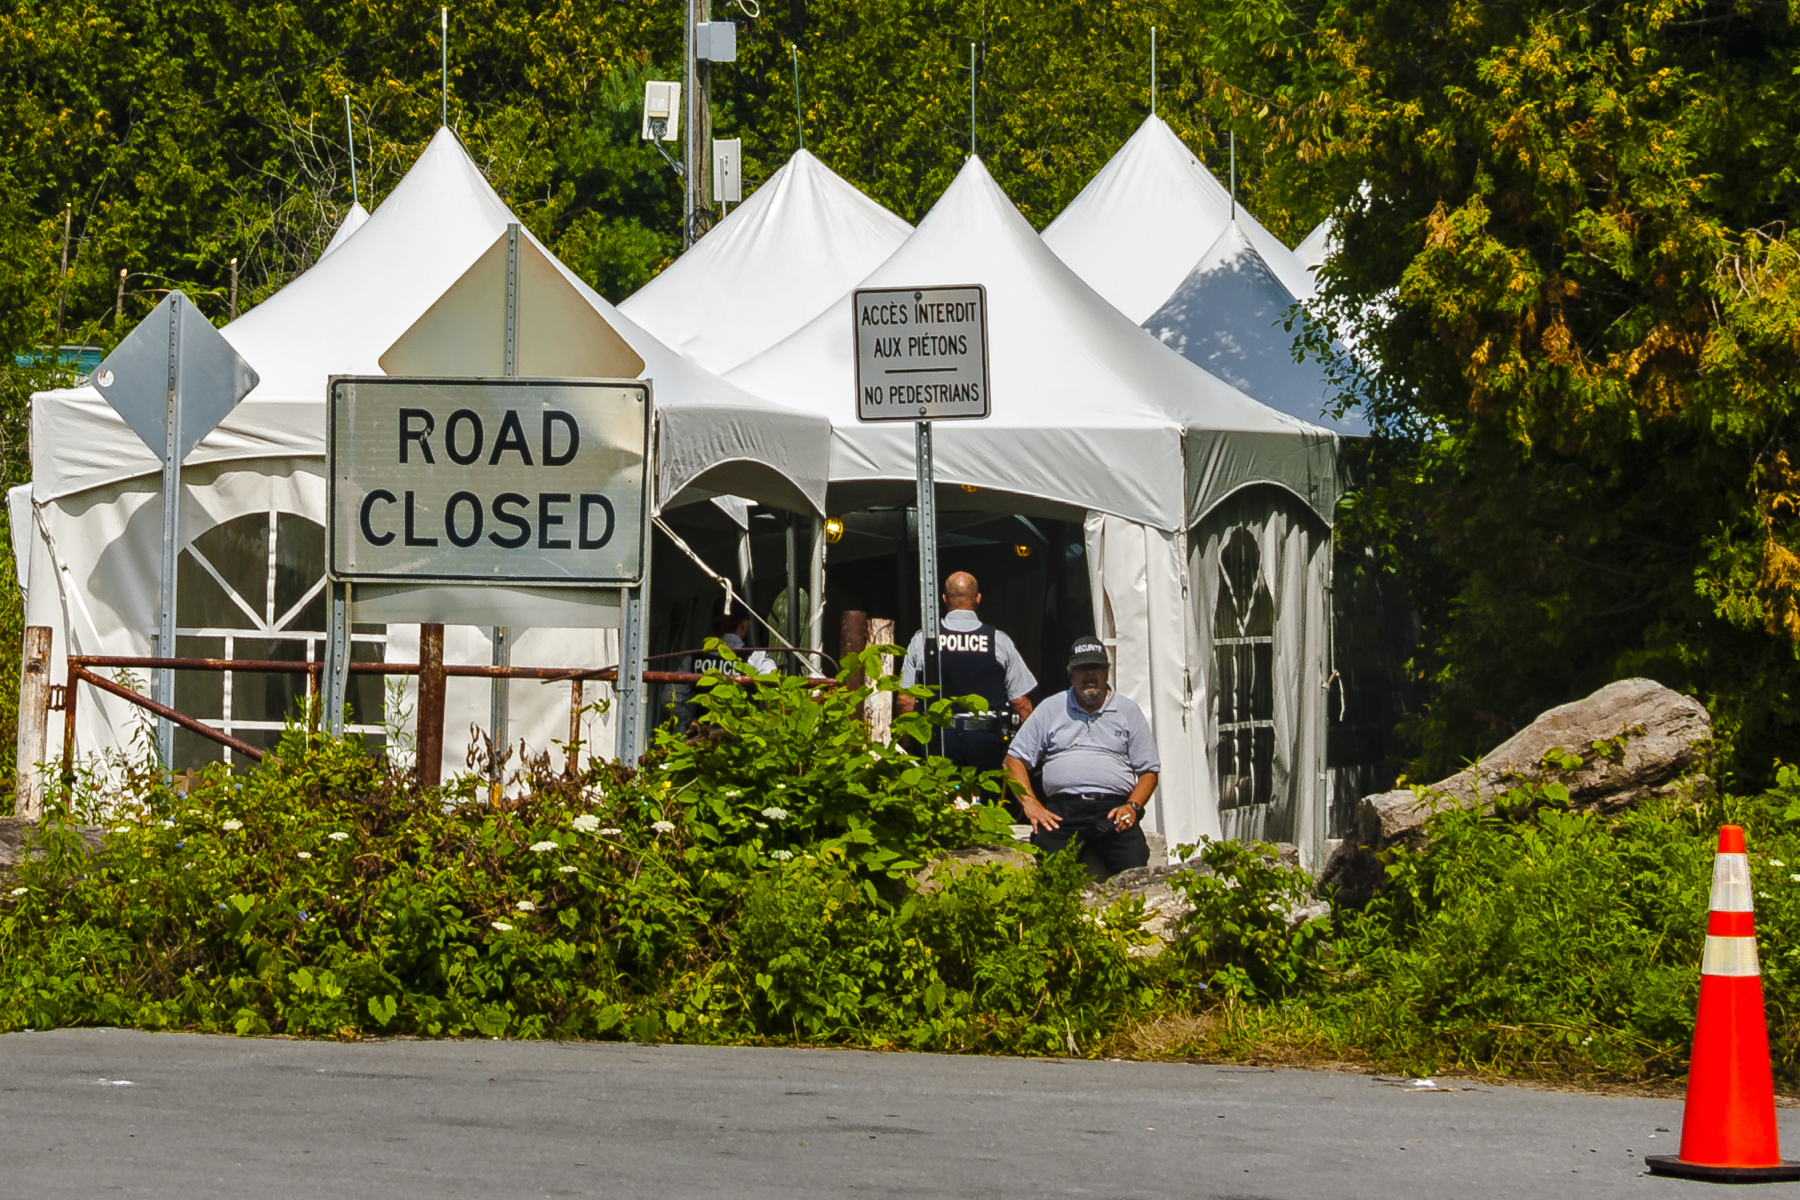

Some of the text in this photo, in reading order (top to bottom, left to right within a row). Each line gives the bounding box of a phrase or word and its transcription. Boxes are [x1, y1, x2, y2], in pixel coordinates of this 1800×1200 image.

[861, 301, 977, 326] ACCÈS INTERDIT
[873, 332, 968, 358] AUX PIÉTONS
[864, 383, 979, 405] NO PEDESTRIANS
[399, 407, 580, 467] ROAD
[359, 488, 615, 550] CLOSED
[939, 634, 988, 652] POLICE
